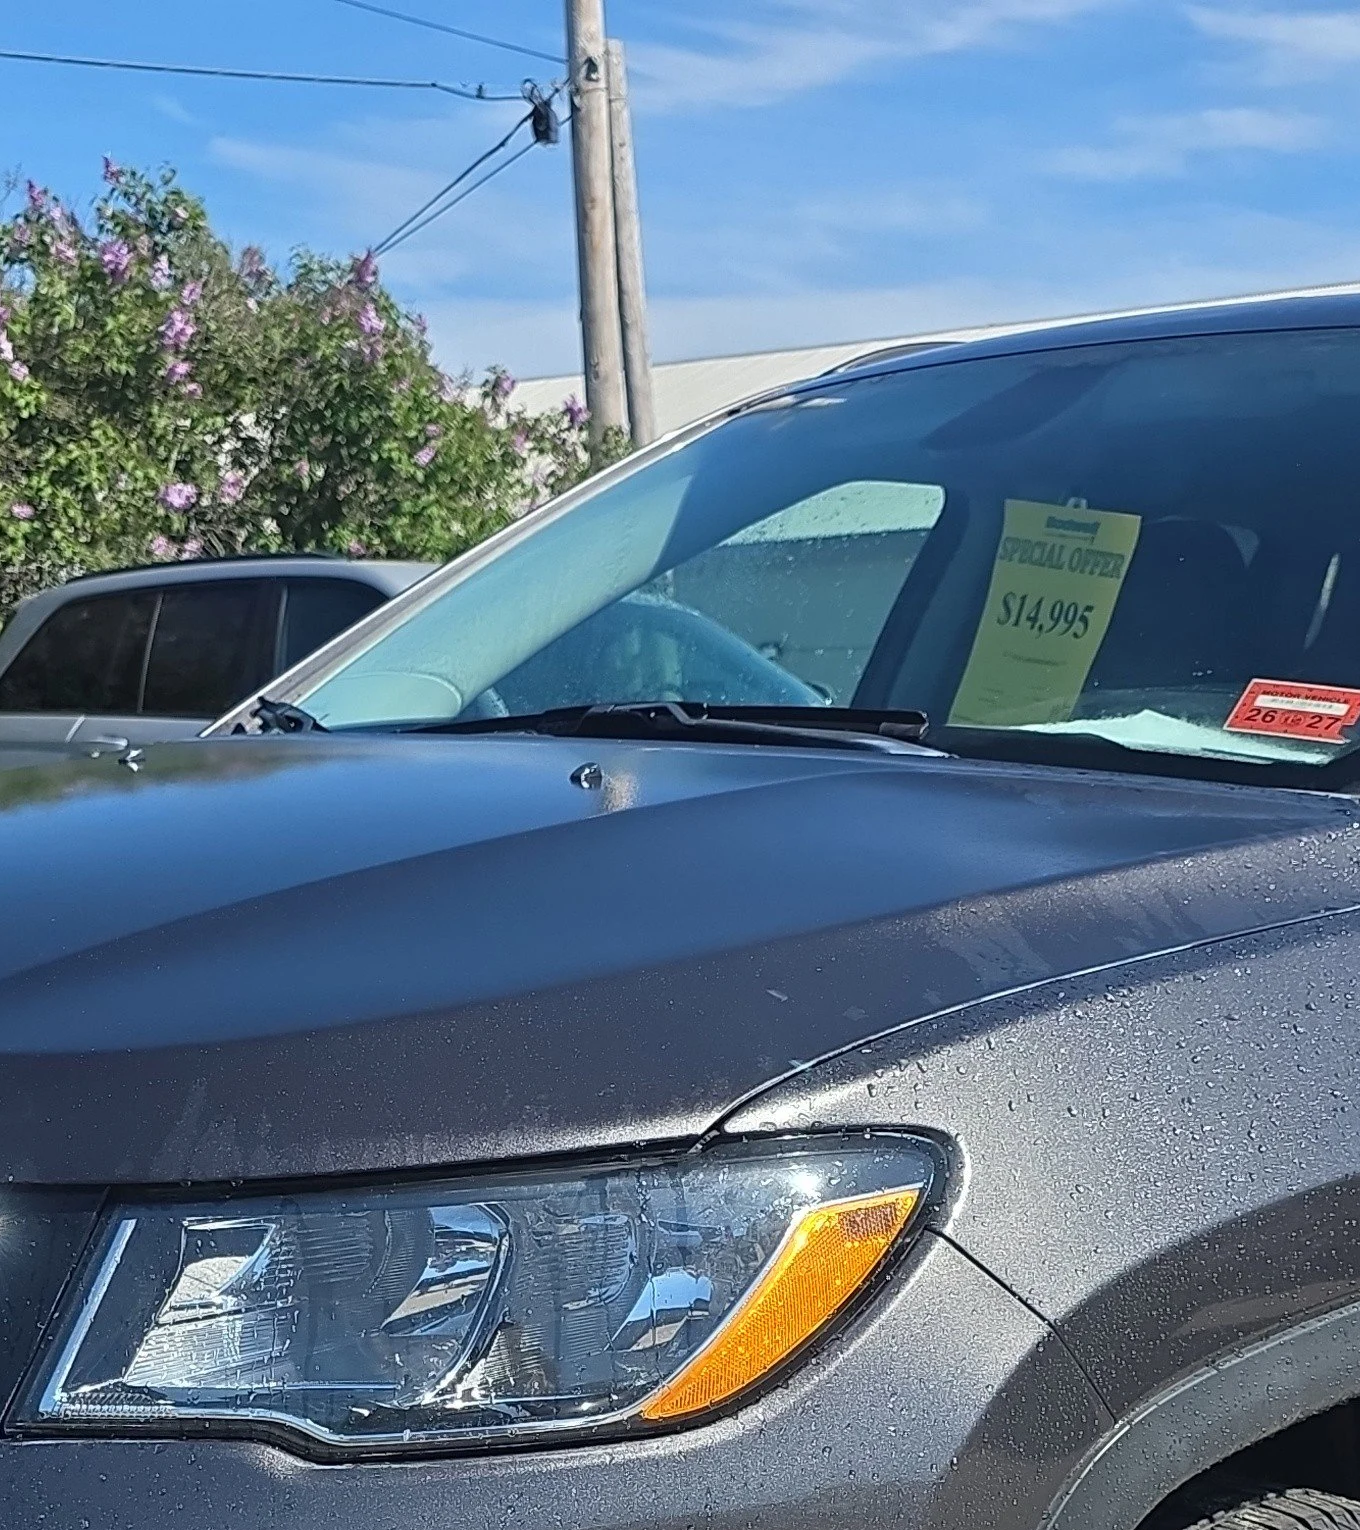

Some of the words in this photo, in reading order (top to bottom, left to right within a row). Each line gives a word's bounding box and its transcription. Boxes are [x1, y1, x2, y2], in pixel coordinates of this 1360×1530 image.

[1000, 536, 1065, 570] SPECIAL
[1069, 547, 1125, 580] OFFER
[997, 591, 1095, 640] $14,995
[1244, 708, 1278, 724] 26
[1306, 714, 1341, 731] 27
